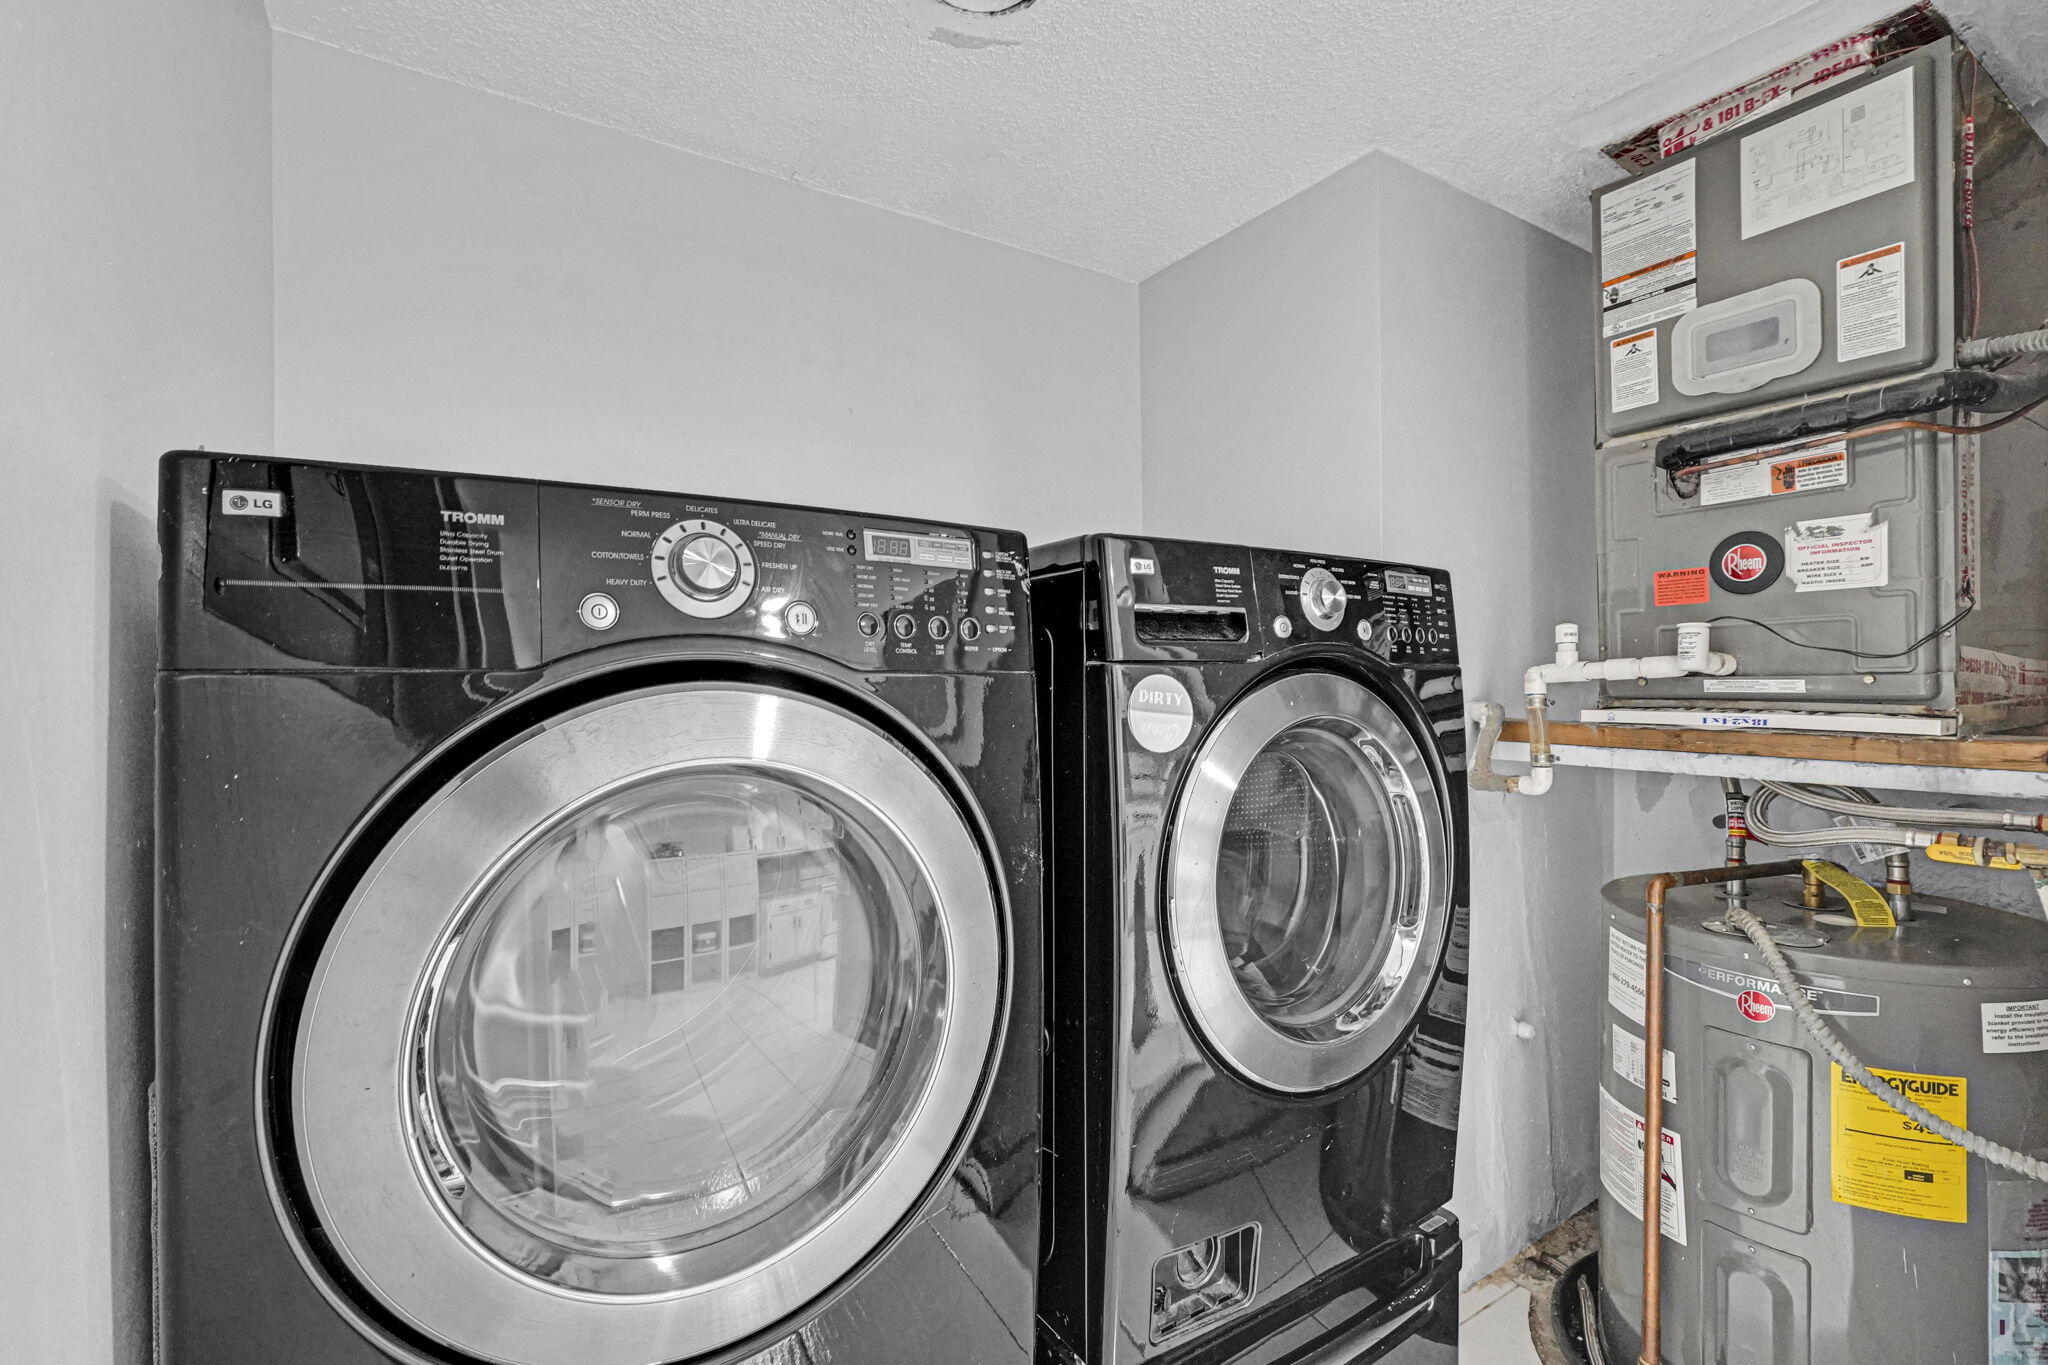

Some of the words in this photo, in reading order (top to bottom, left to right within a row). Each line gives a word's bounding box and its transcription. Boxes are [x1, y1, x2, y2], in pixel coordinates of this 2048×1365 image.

[1702, 117, 1713, 132] &
[1718, 103, 1741, 126] 181
[253, 499, 273, 509] LG
[626, 500, 642, 508] DRY
[685, 505, 719, 514] DELICATES
[440, 510, 505, 526] TROMM
[651, 511, 671, 519] PRESS
[733, 518, 750, 526] ULTRA
[751, 520, 776, 528] DELICATE
[457, 532, 488, 540] Capacity
[621, 530, 652, 539] NORMAL
[788, 533, 801, 541] DRY
[468, 540, 489, 548] Drying
[753, 540, 773, 548] SPEED
[774, 541, 786, 549] DRY
[1831, 538, 1873, 548] INSPECTOR
[591, 551, 644, 560] COTTON/TOWELS
[1810, 547, 1861, 556] INFORMATION
[459, 555, 493, 563] Operation
[1728, 548, 1762, 576] Rheem
[761, 561, 788, 570] FRESHEN
[1213, 566, 1240, 575] TROMM
[1657, 568, 1706, 579] WARNING
[1139, 688, 1183, 706] DIRTY
[1741, 992, 1773, 1017] Rheem
[2006, 1004, 2040, 1012] IMPORTANT
